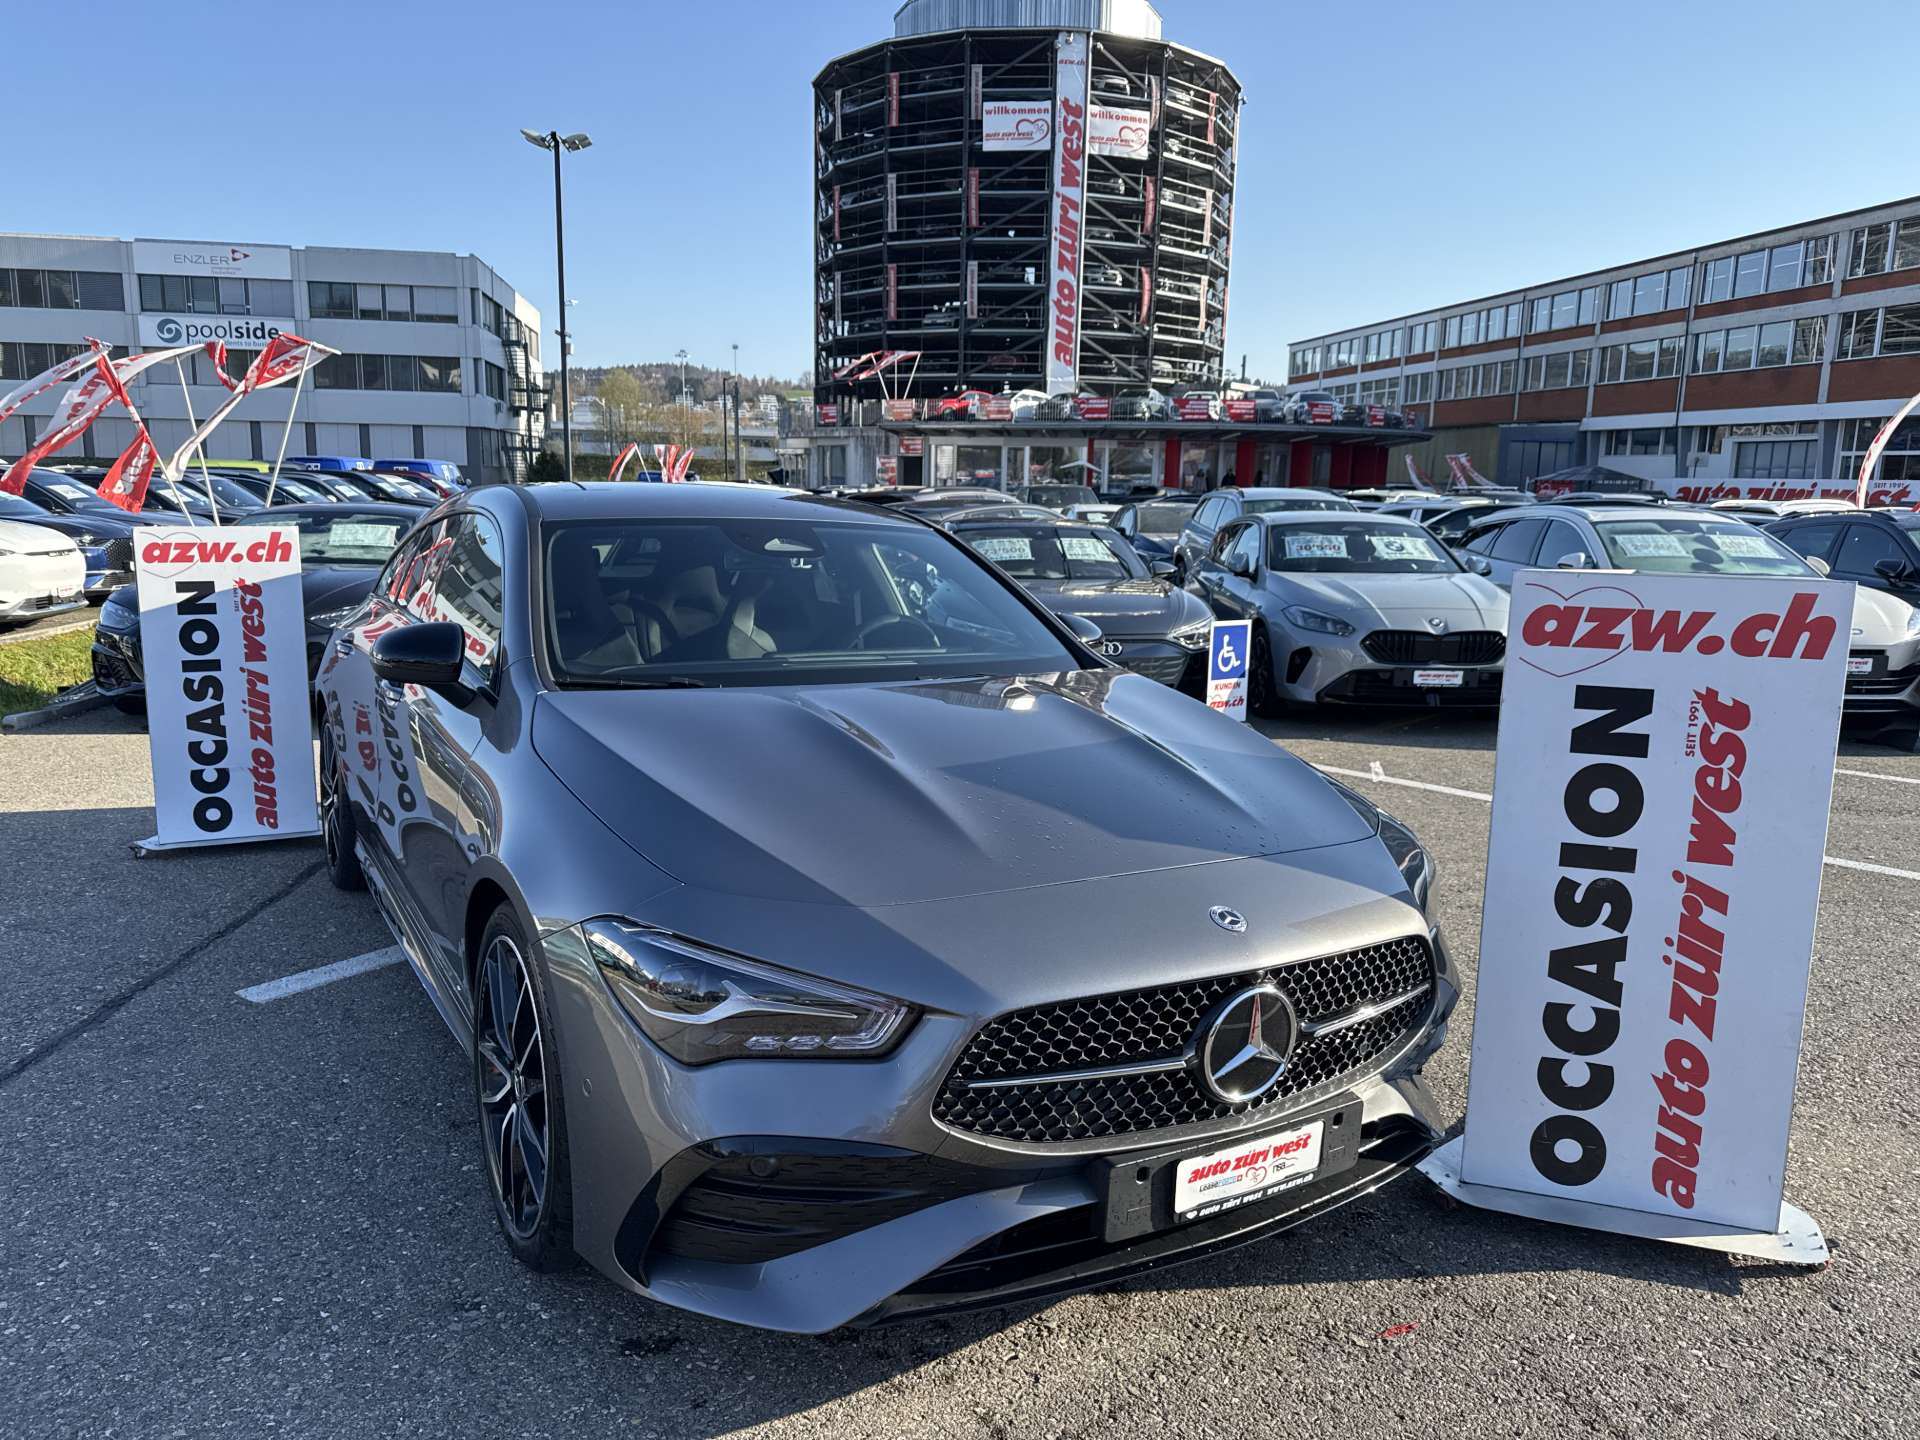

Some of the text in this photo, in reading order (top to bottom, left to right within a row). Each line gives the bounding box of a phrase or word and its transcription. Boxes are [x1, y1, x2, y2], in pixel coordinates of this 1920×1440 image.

[985, 106, 1050, 115] willkommen
[1090, 111, 1148, 124] willkommen
[1052, 96, 1083, 367] auto züri west
[173, 254, 230, 265] ENZLER
[186, 321, 279, 344] poolside
[1676, 481, 1742, 501] auto
[1747, 481, 1818, 501] züri
[141, 531, 293, 564] azw.ch
[1521, 592, 1838, 661] azw.ch
[175, 580, 233, 833] OCCASION
[232, 576, 279, 830] auto züri west
[1685, 700, 1700, 757] SEIT 1991
[1529, 685, 1656, 1187] OCCASION
[1651, 686, 1752, 1211] auto züri west
[1187, 1133, 1312, 1184] auto züri west
[1199, 1204, 1221, 1216] auto
[1221, 1196, 1242, 1210] züri
[1242, 1190, 1263, 1203] west
